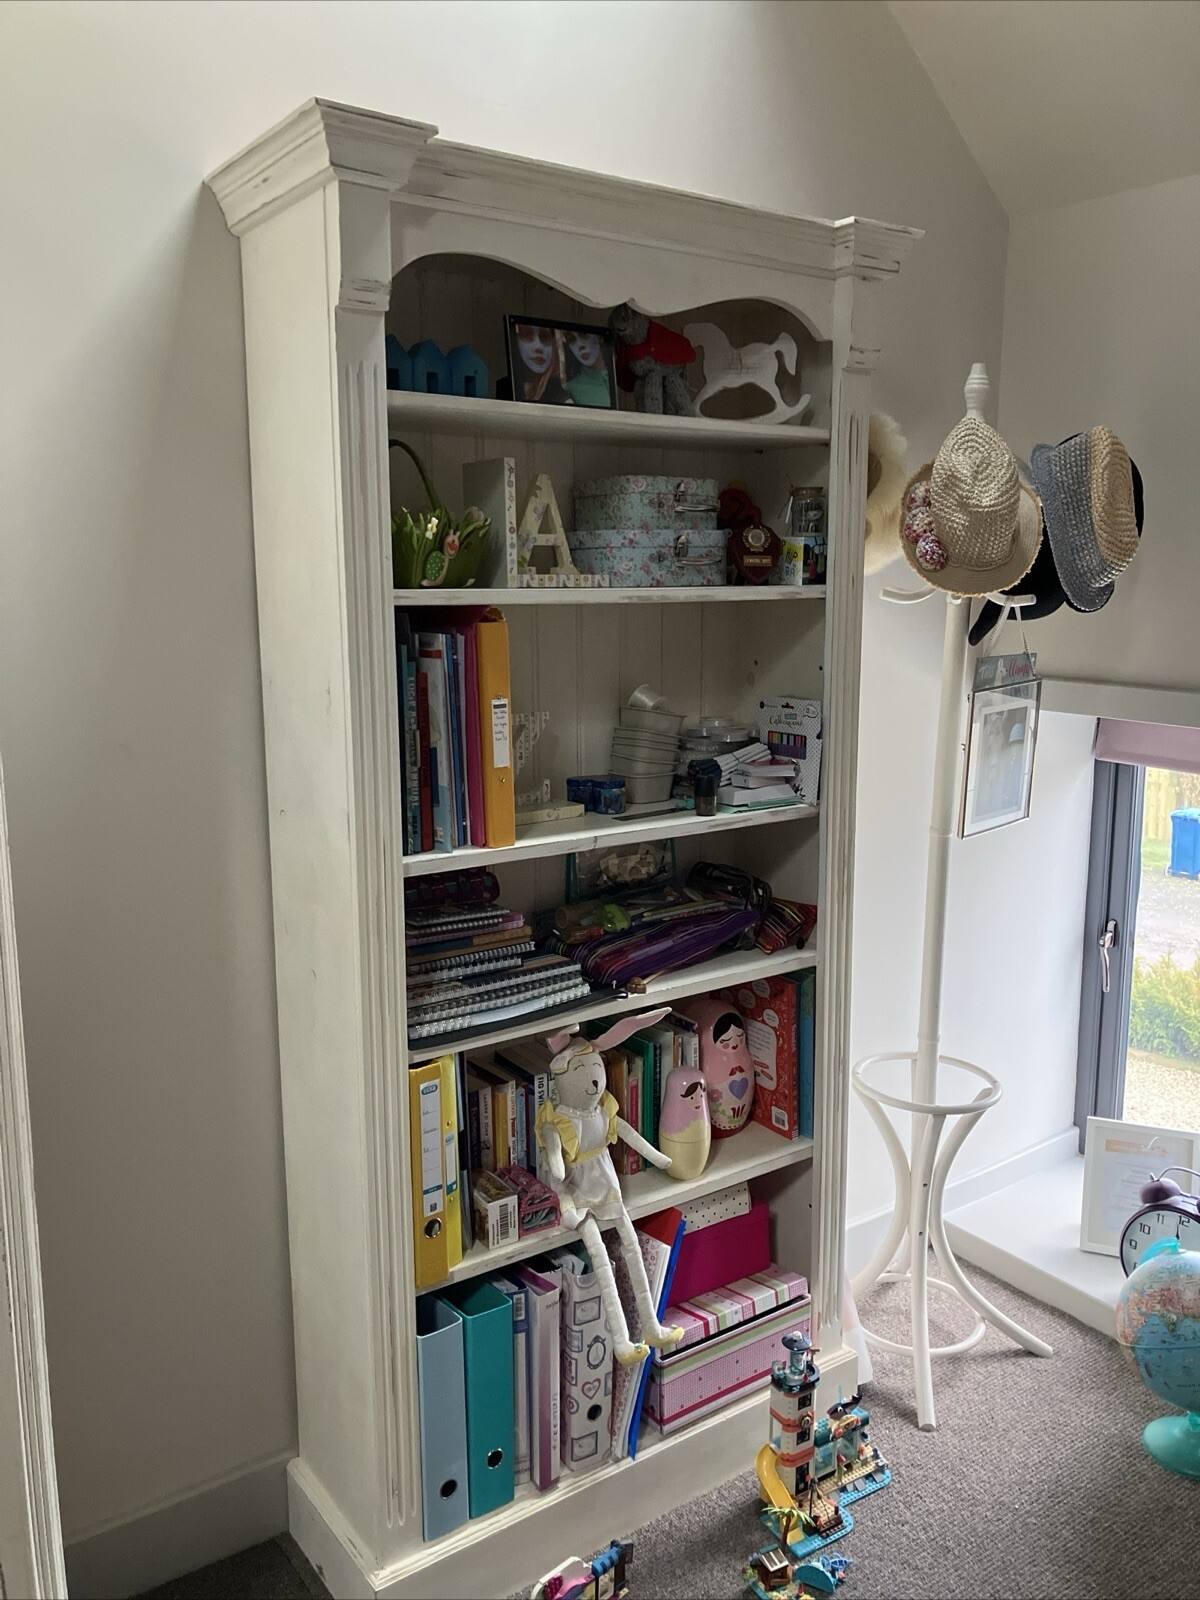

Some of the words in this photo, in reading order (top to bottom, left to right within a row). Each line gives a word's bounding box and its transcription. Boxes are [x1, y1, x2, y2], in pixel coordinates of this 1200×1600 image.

[1156, 1212, 1165, 1225] 11
[1178, 1214, 1191, 1228] 12
[1139, 1222, 1151, 1235] 10
[1129, 1238, 1138, 1250] 9
